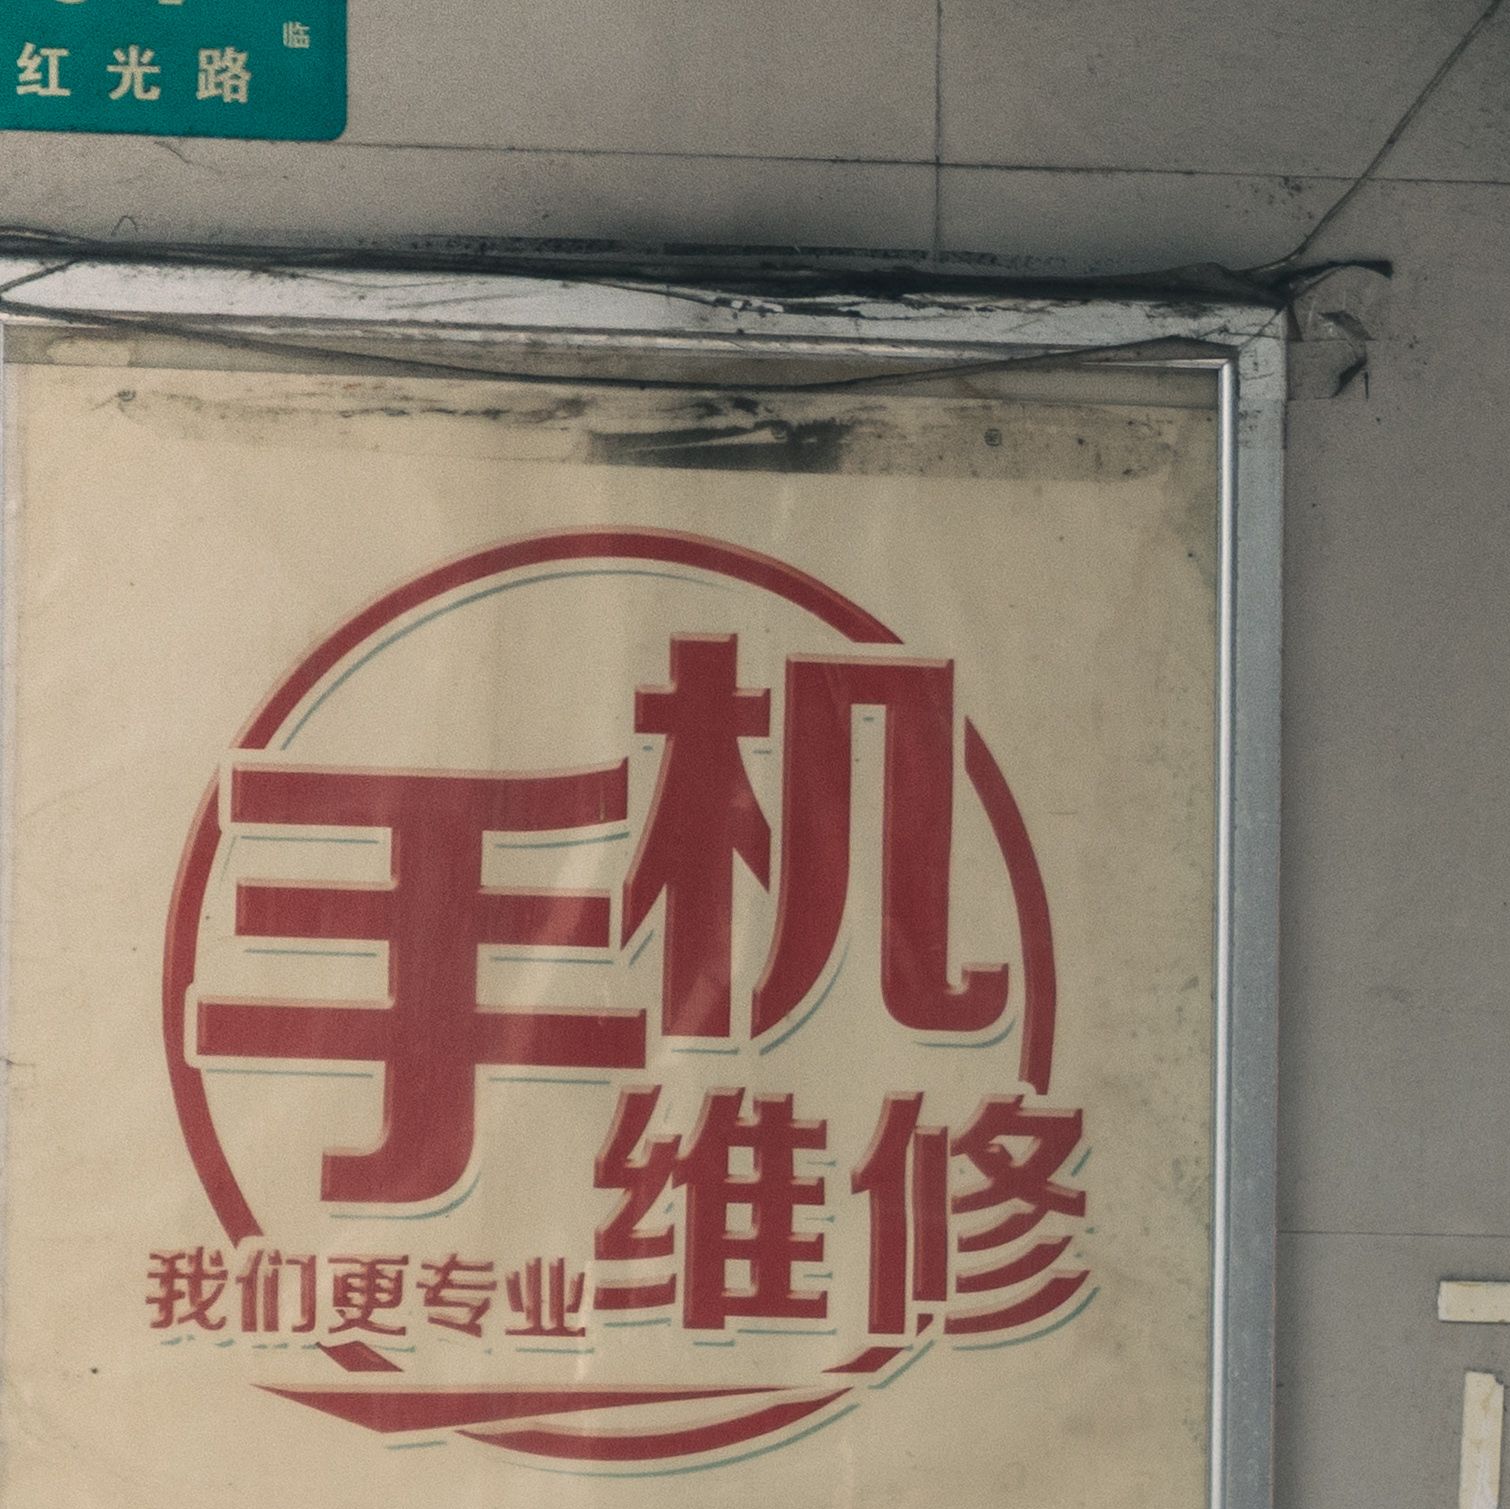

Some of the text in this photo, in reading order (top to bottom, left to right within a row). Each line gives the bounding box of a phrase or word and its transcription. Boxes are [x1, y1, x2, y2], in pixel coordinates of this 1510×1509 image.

[16, 42, 252, 103] 红光路
[282, 21, 310, 49] 临
[194, 630, 1013, 1206] 手机
[593, 1084, 1095, 1337] 维修
[144, 1249, 588, 1338] 我们更专业
